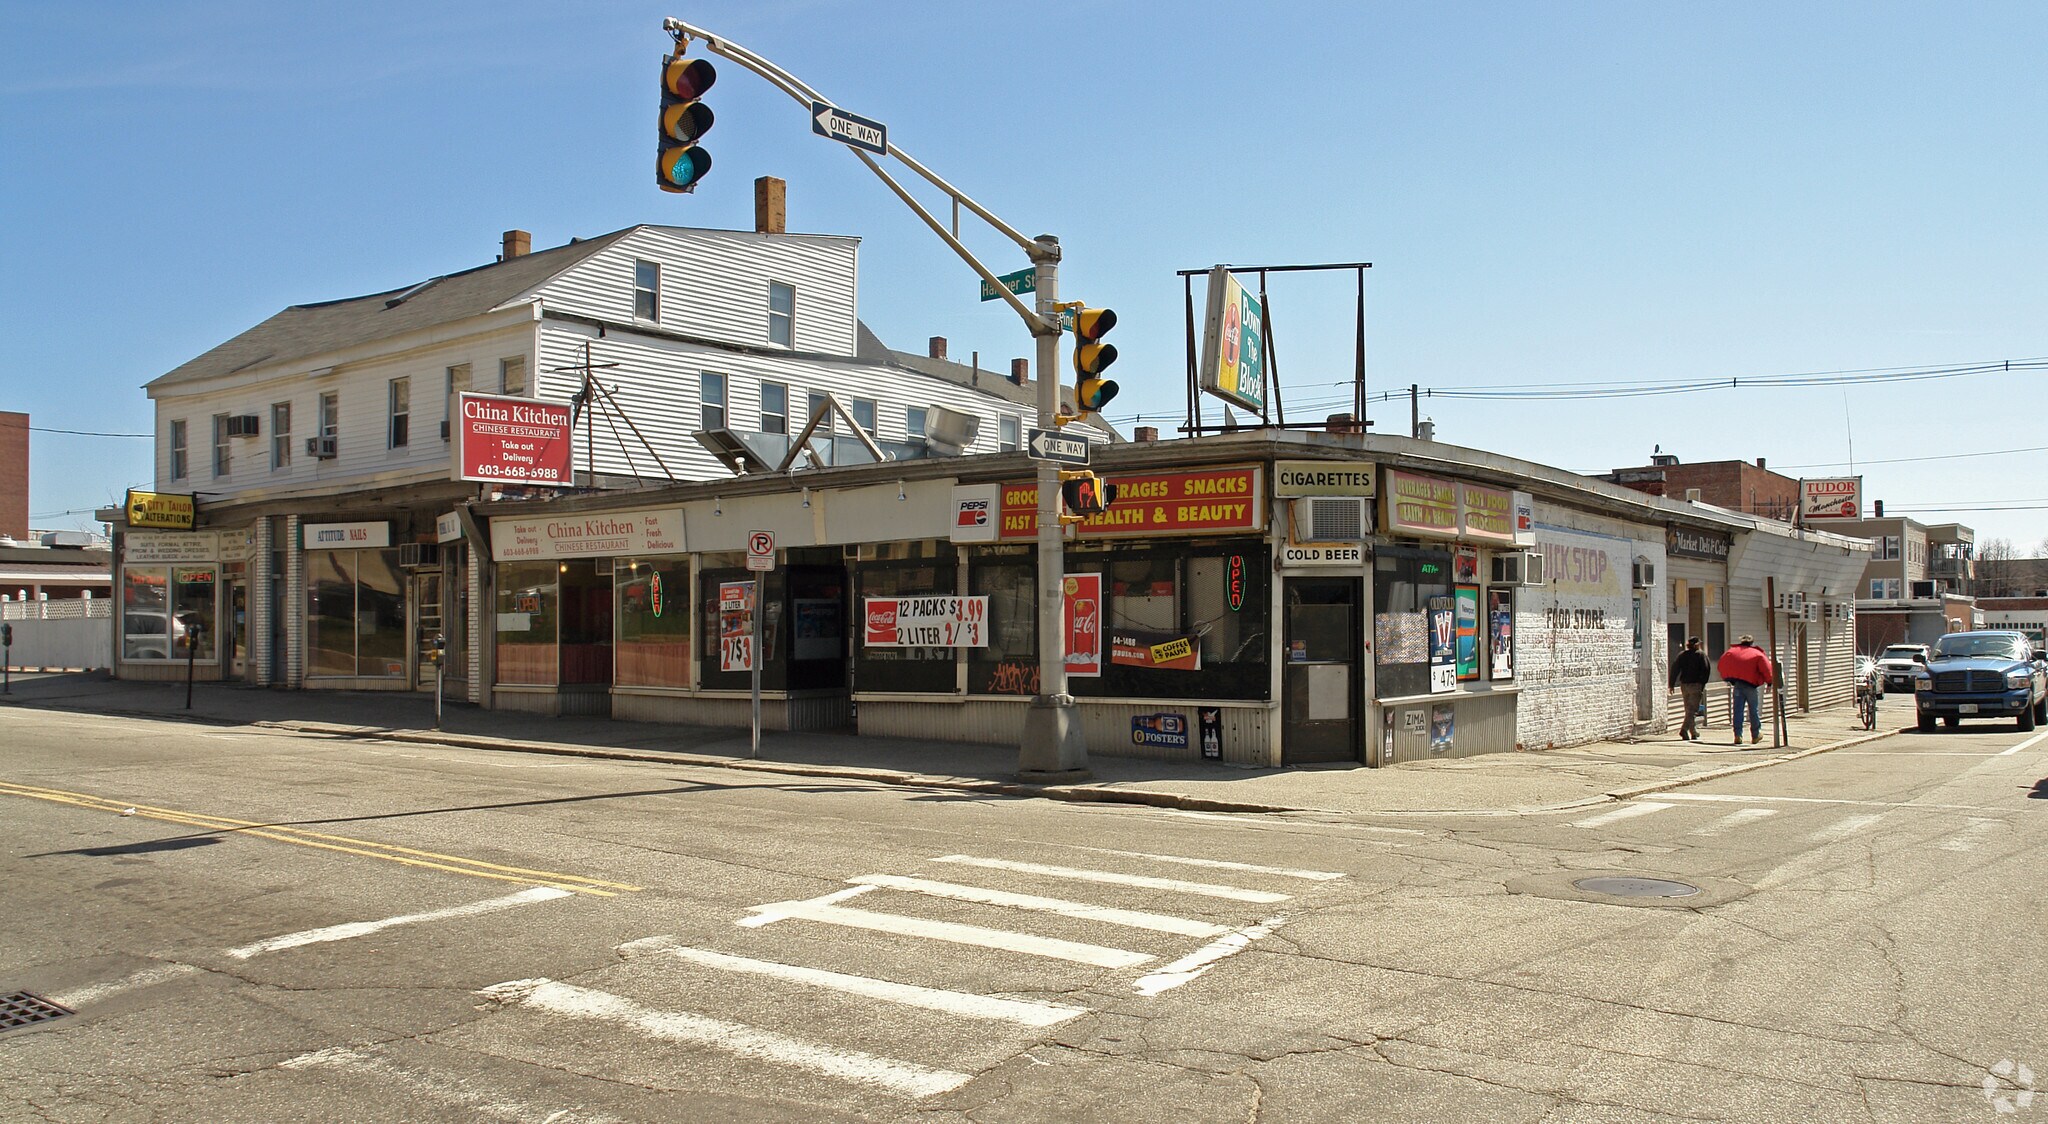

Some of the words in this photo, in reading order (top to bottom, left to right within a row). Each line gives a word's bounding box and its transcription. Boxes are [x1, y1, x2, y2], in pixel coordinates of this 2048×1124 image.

[830, 117, 852, 136] ONE
[858, 126, 880, 144] WAY
[982, 280, 1020, 297] Haver
[464, 401, 508, 422] China
[512, 405, 568, 426] Kitchen
[472, 424, 508, 434] CHINESE
[510, 426, 560, 438] RESTAURANT
[501, 440, 519, 450] Take
[521, 442, 534, 451] out
[1044, 440, 1062, 452] ONE
[1066, 442, 1084, 455] WAY
[503, 452, 534, 465] Delivery
[478, 464, 558, 479] 603-668-6988
[1184, 476, 1247, 496] SNACKS
[1280, 472, 1370, 486] CIGARETTES
[1397, 478, 1431, 498] BEVERAGES
[1806, 482, 1856, 492] TUDOR
[148, 500, 165, 511] CITY
[168, 500, 192, 513] TAILOR
[960, 501, 988, 510] PEPSI
[1466, 490, 1484, 506] FAST
[1487, 493, 1508, 511] FOOD
[1808, 494, 1855, 513] Manchester
[145, 513, 191, 524] ALTERATIONS
[1084, 508, 1144, 526] HEALTH
[1152, 507, 1169, 523] &
[1178, 504, 1246, 522] BEAUTY
[1518, 507, 1531, 516] PEPSI
[645, 517, 658, 525] Fast
[1005, 515, 1031, 530] FAST
[318, 529, 345, 542] ATTITUDE
[350, 528, 367, 541] NAILS
[514, 525, 526, 533] Take
[548, 522, 583, 539] China
[585, 518, 634, 537] Kitchen
[646, 528, 662, 537] Fresh
[516, 536, 538, 546] Delivery
[555, 542, 583, 551] CHINESE
[585, 539, 629, 550] RESTAURANT
[647, 540, 674, 549] Delicious
[1674, 532, 1698, 553] Market
[1286, 549, 1320, 560] COLD
[1325, 549, 1359, 560] BEER
[1535, 542, 1570, 580] UICK
[1572, 547, 1607, 583] STOP
[181, 572, 212, 582] OPEN
[1231, 555, 1240, 606] OPEN
[519, 597, 538, 612] OPEN
[729, 601, 741, 609] LITER
[899, 600, 909, 617] 12
[913, 599, 946, 617] PACKS
[949, 599, 983, 622] $3.99
[869, 610, 896, 624] Coca-Cola
[1546, 607, 1570, 629] FOOD
[1573, 608, 1605, 629] STORE
[897, 628, 904, 645] 2
[908, 627, 940, 645] LITER
[1162, 640, 1188, 652] COFFEE
[1165, 647, 1187, 658] PAUSE
[1433, 670, 1436, 680] $
[1441, 669, 1454, 687] 475
[1406, 714, 1424, 726] ZIMA
[1145, 733, 1185, 744] FOSTER'S
